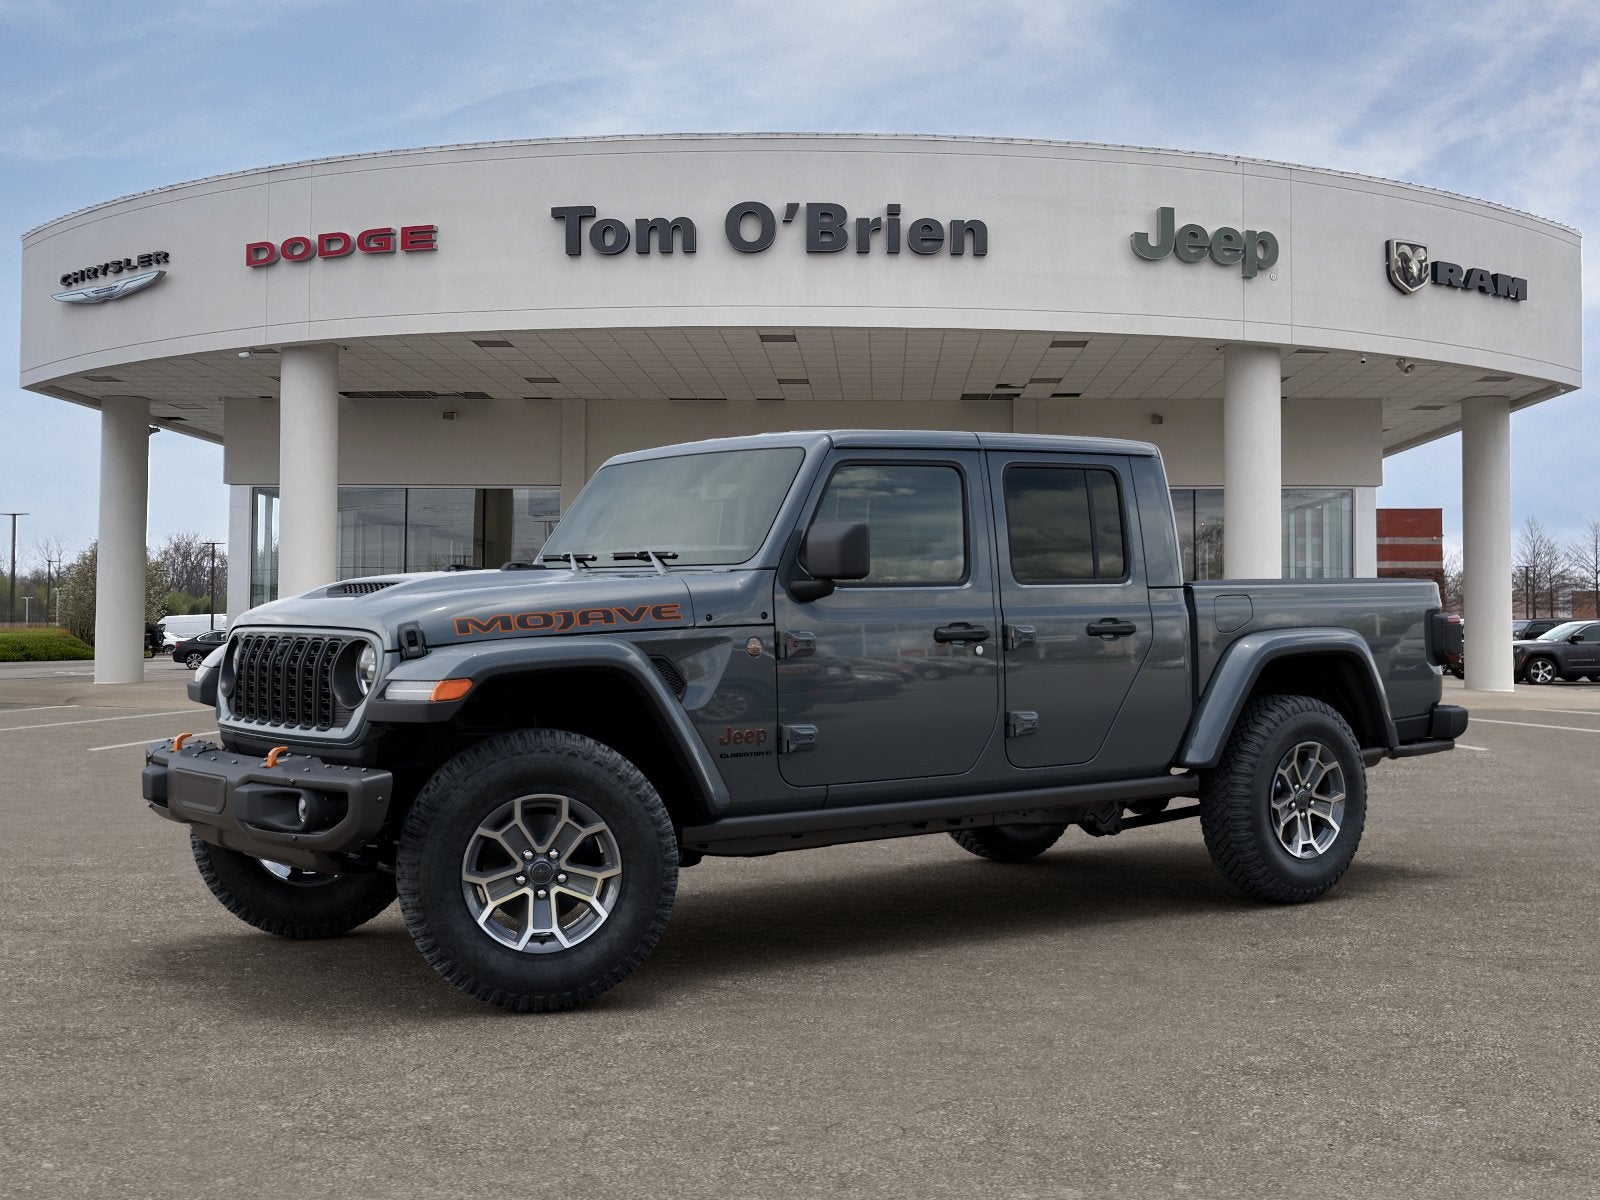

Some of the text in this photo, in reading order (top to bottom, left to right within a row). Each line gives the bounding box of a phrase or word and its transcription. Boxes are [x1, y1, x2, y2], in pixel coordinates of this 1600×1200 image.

[246, 225, 438, 268] DODGE
[551, 201, 988, 257] Tom O'Brien
[1130, 206, 1279, 278] Jeep
[60, 250, 170, 286] CHRYSLER
[1430, 261, 1528, 301] RAM
[454, 603, 682, 636] MOJAVE
[717, 726, 767, 746] Jeep
